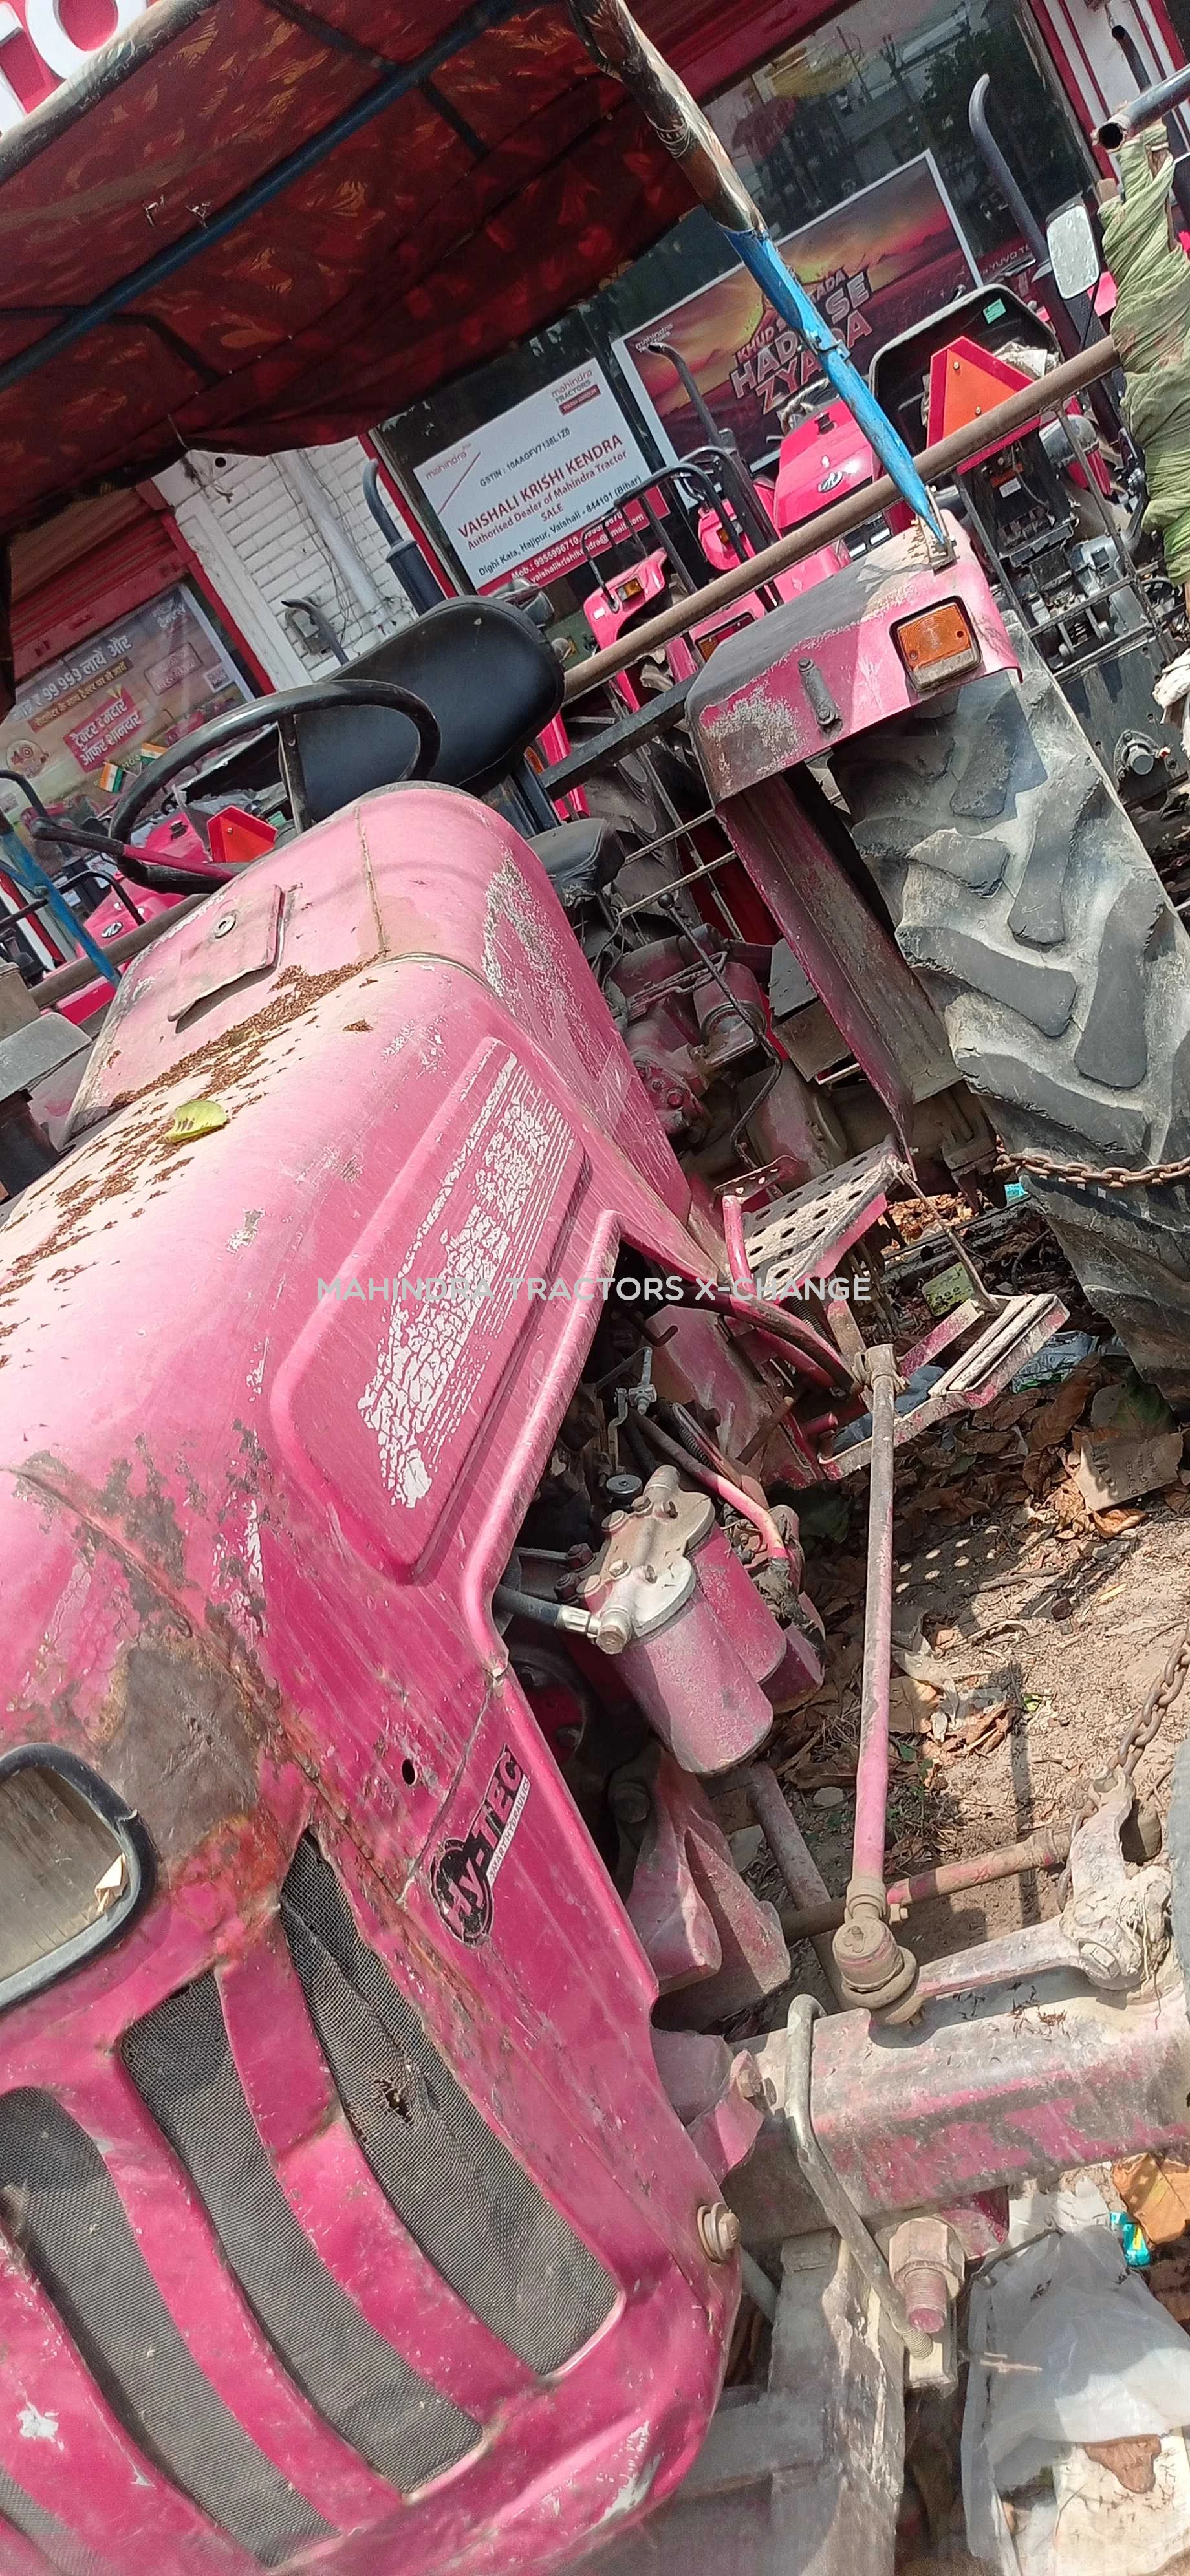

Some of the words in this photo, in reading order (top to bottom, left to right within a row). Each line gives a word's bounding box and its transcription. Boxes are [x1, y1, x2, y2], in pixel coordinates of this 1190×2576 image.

[635, 323, 673, 349] mahindra
[731, 330, 805, 399] HAD
[825, 272, 870, 325] SE
[737, 327, 775, 363] KHUD
[551, 369, 592, 398] mahindra
[555, 379, 591, 404] TRACTORS
[425, 451, 468, 481] mahindra
[479, 469, 503, 488] GSTIN
[458, 495, 520, 539] VAISHALI
[520, 466, 565, 502] KRISHI
[565, 434, 623, 475] KENDRA
[468, 519, 514, 551] Authorised
[514, 500, 542, 522] Dealer
[544, 491, 554, 505] of
[553, 470, 596, 497] Mahindra
[595, 451, 627, 473] Tractor
[479, 558, 499, 576] Dighi
[501, 548, 521, 564] Kala,
[520, 530, 550, 553] Hajipur,
[550, 511, 581, 535] Vaishali
[586, 491, 614, 513] 844101
[614, 475, 642, 499] (Bihar)
[541, 503, 564, 522] SALE
[106, 634, 132, 658] और
[96, 698, 128, 727] दमदार
[80, 738, 109, 766] ऑफर
[105, 713, 142, 745] शानदार
[446, 1750, 522, 1940] Hy-TEC
[488, 1838, 508, 1879] SMART
[505, 1778, 530, 1841] HYDRAULICS
